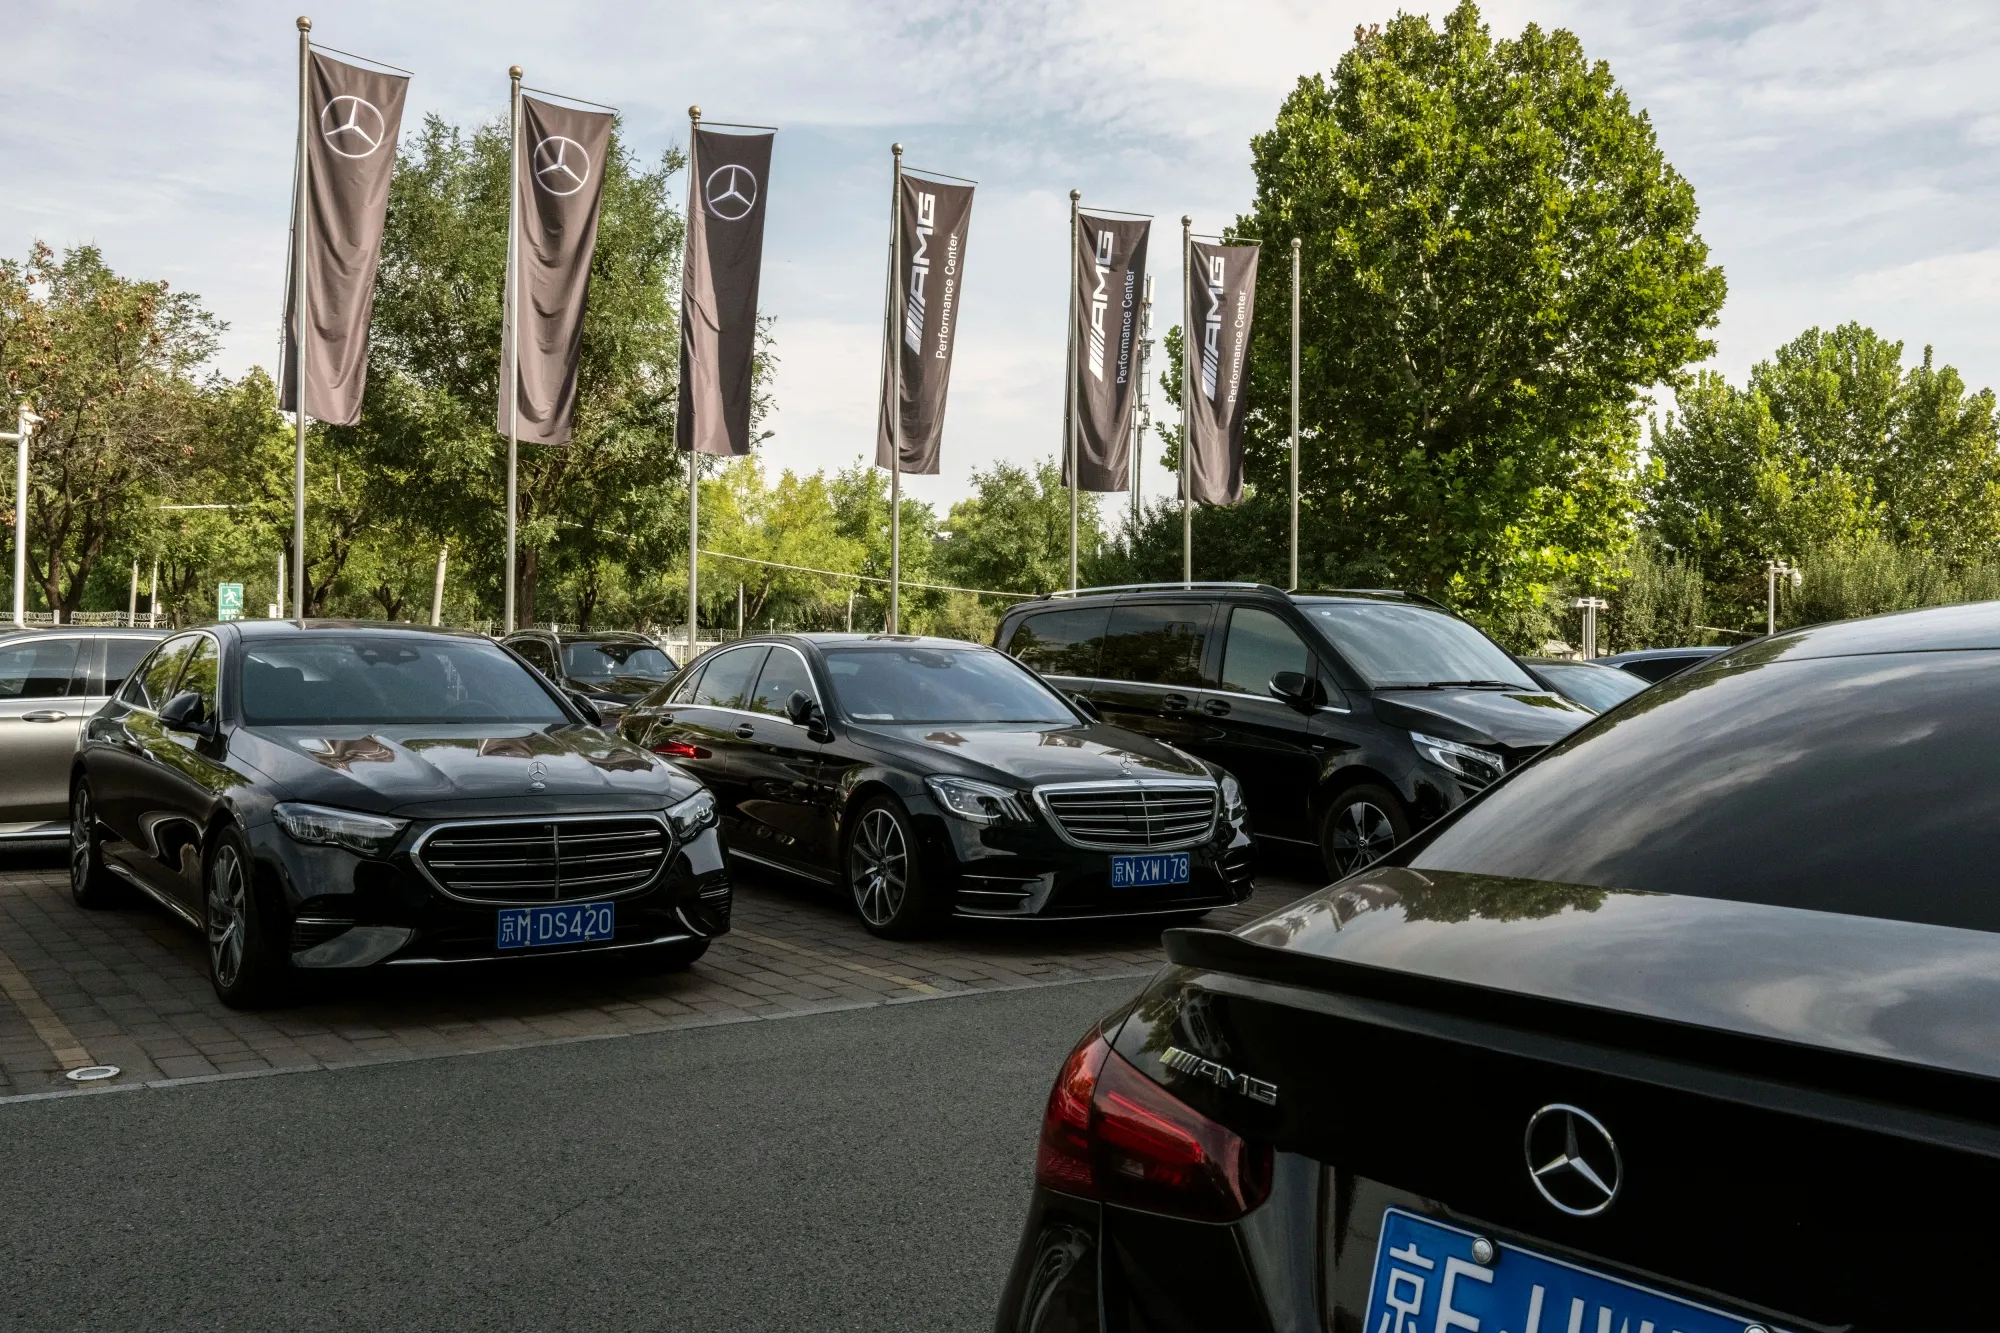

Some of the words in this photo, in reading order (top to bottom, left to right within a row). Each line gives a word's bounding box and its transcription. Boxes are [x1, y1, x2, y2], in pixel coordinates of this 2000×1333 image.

[944, 233, 958, 275] Center
[1122, 269, 1135, 310] Center
[1234, 290, 1247, 329] Center
[936, 278, 954, 359] Performance
[1117, 311, 1132, 384] Performance
[1228, 331, 1243, 402] Performance
